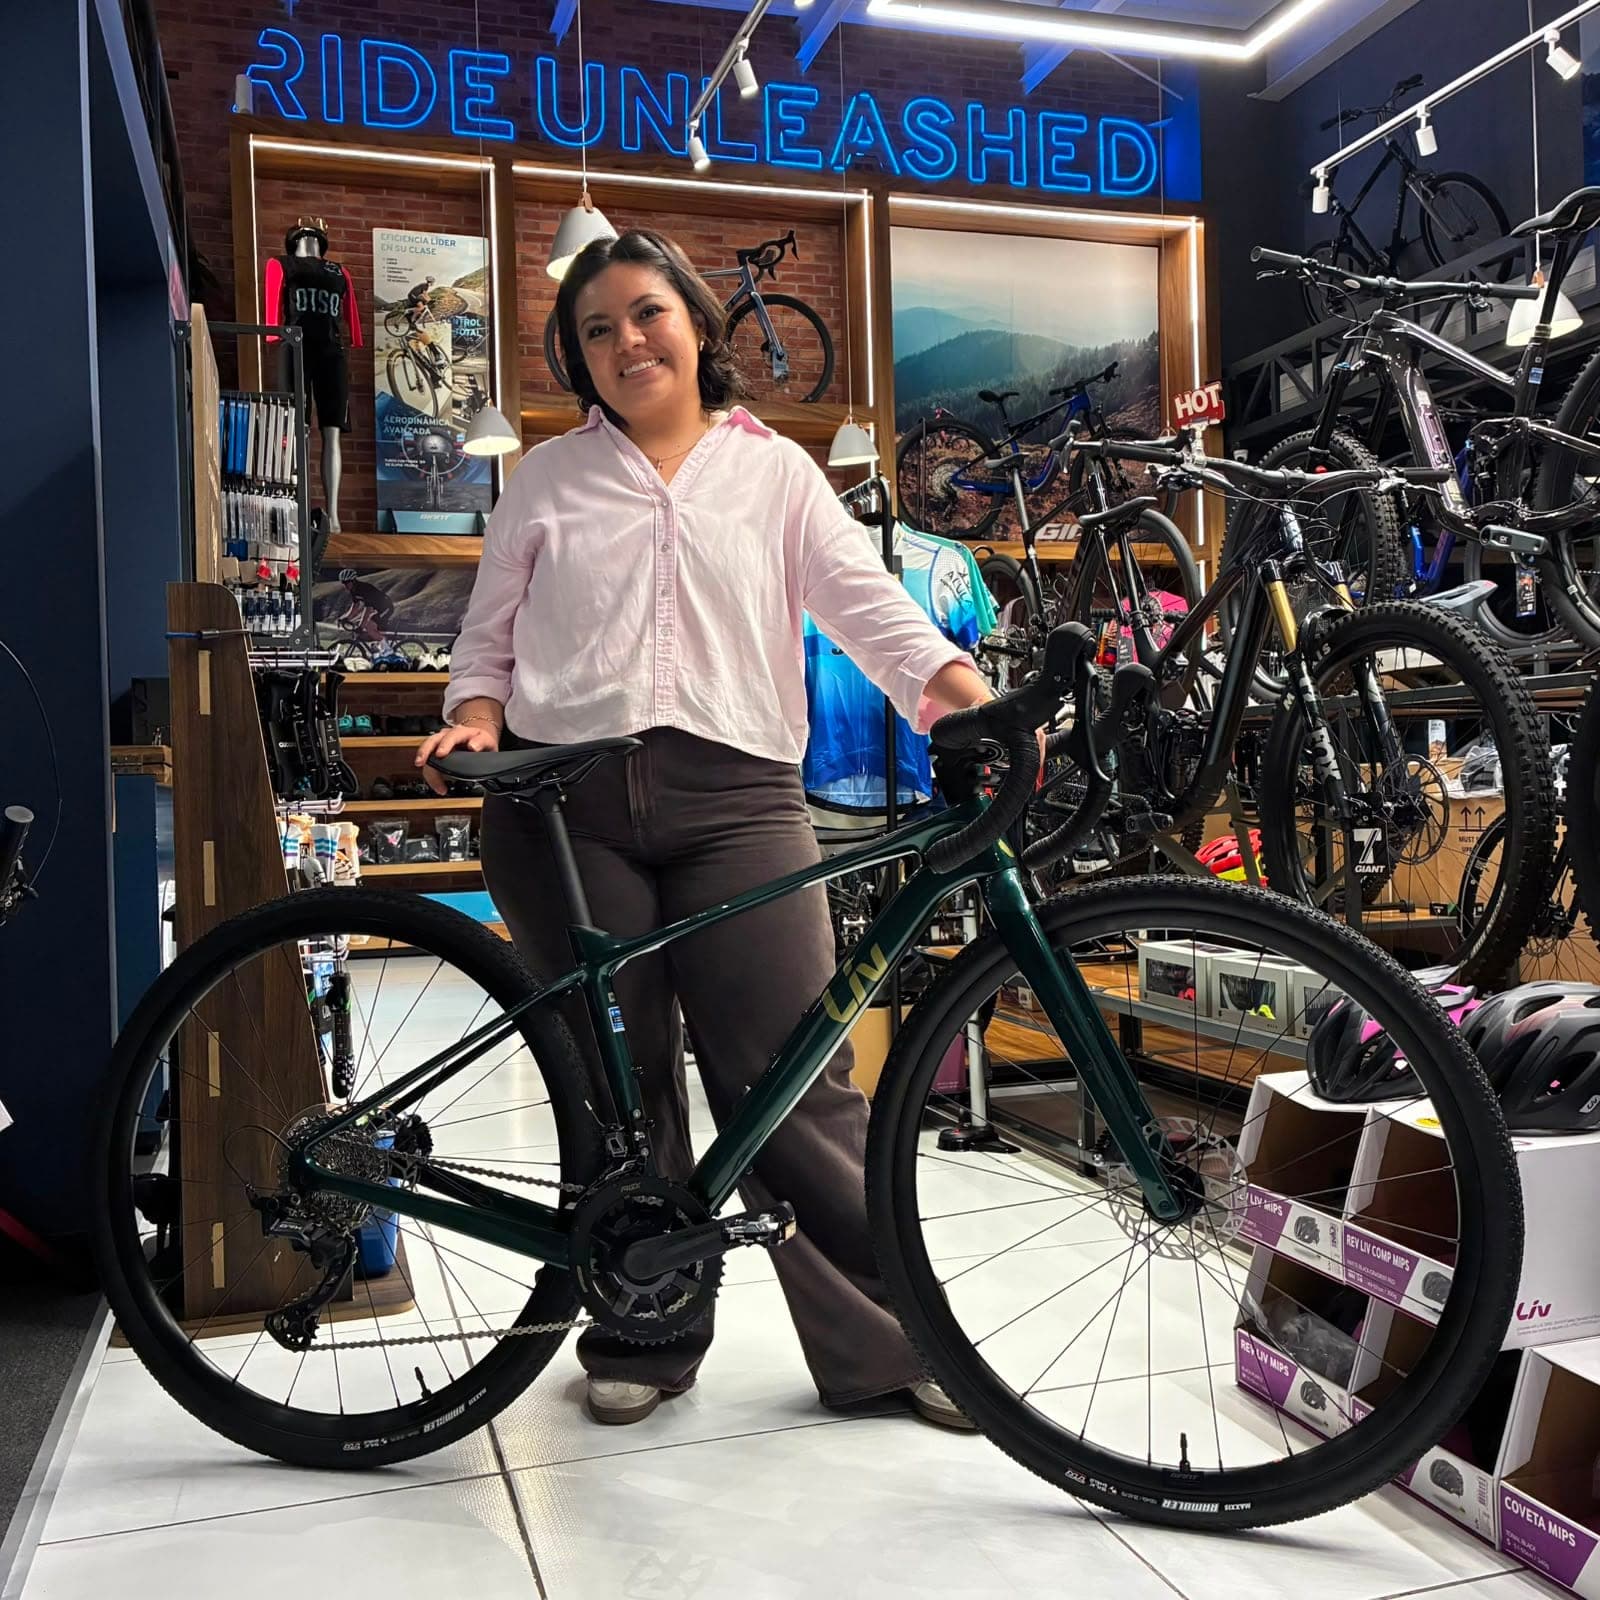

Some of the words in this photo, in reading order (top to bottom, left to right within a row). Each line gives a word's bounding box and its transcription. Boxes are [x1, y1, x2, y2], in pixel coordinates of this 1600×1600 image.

[232, 28, 515, 141] RIDE
[536, 57, 1158, 195] UNLEASHED
[408, 246, 437, 255] CLASE
[1174, 383, 1220, 420] HOT
[383, 426, 432, 436] AVANZADA
[1354, 865, 1386, 873] GIANT
[821, 942, 889, 1024] Liv
[1346, 1234, 1360, 1249] REV
[1371, 1245, 1392, 1263] COMP
[1392, 1253, 1411, 1272] MIPS
[1516, 1299, 1552, 1321] Liv
[1269, 1357, 1290, 1377] MIPS
[1161, 1498, 1220, 1513] RAMBLER
[1224, 1502, 1251, 1511] MAXXIS
[1504, 1496, 1546, 1531] COVETA
[1548, 1520, 1576, 1547] MIPS
